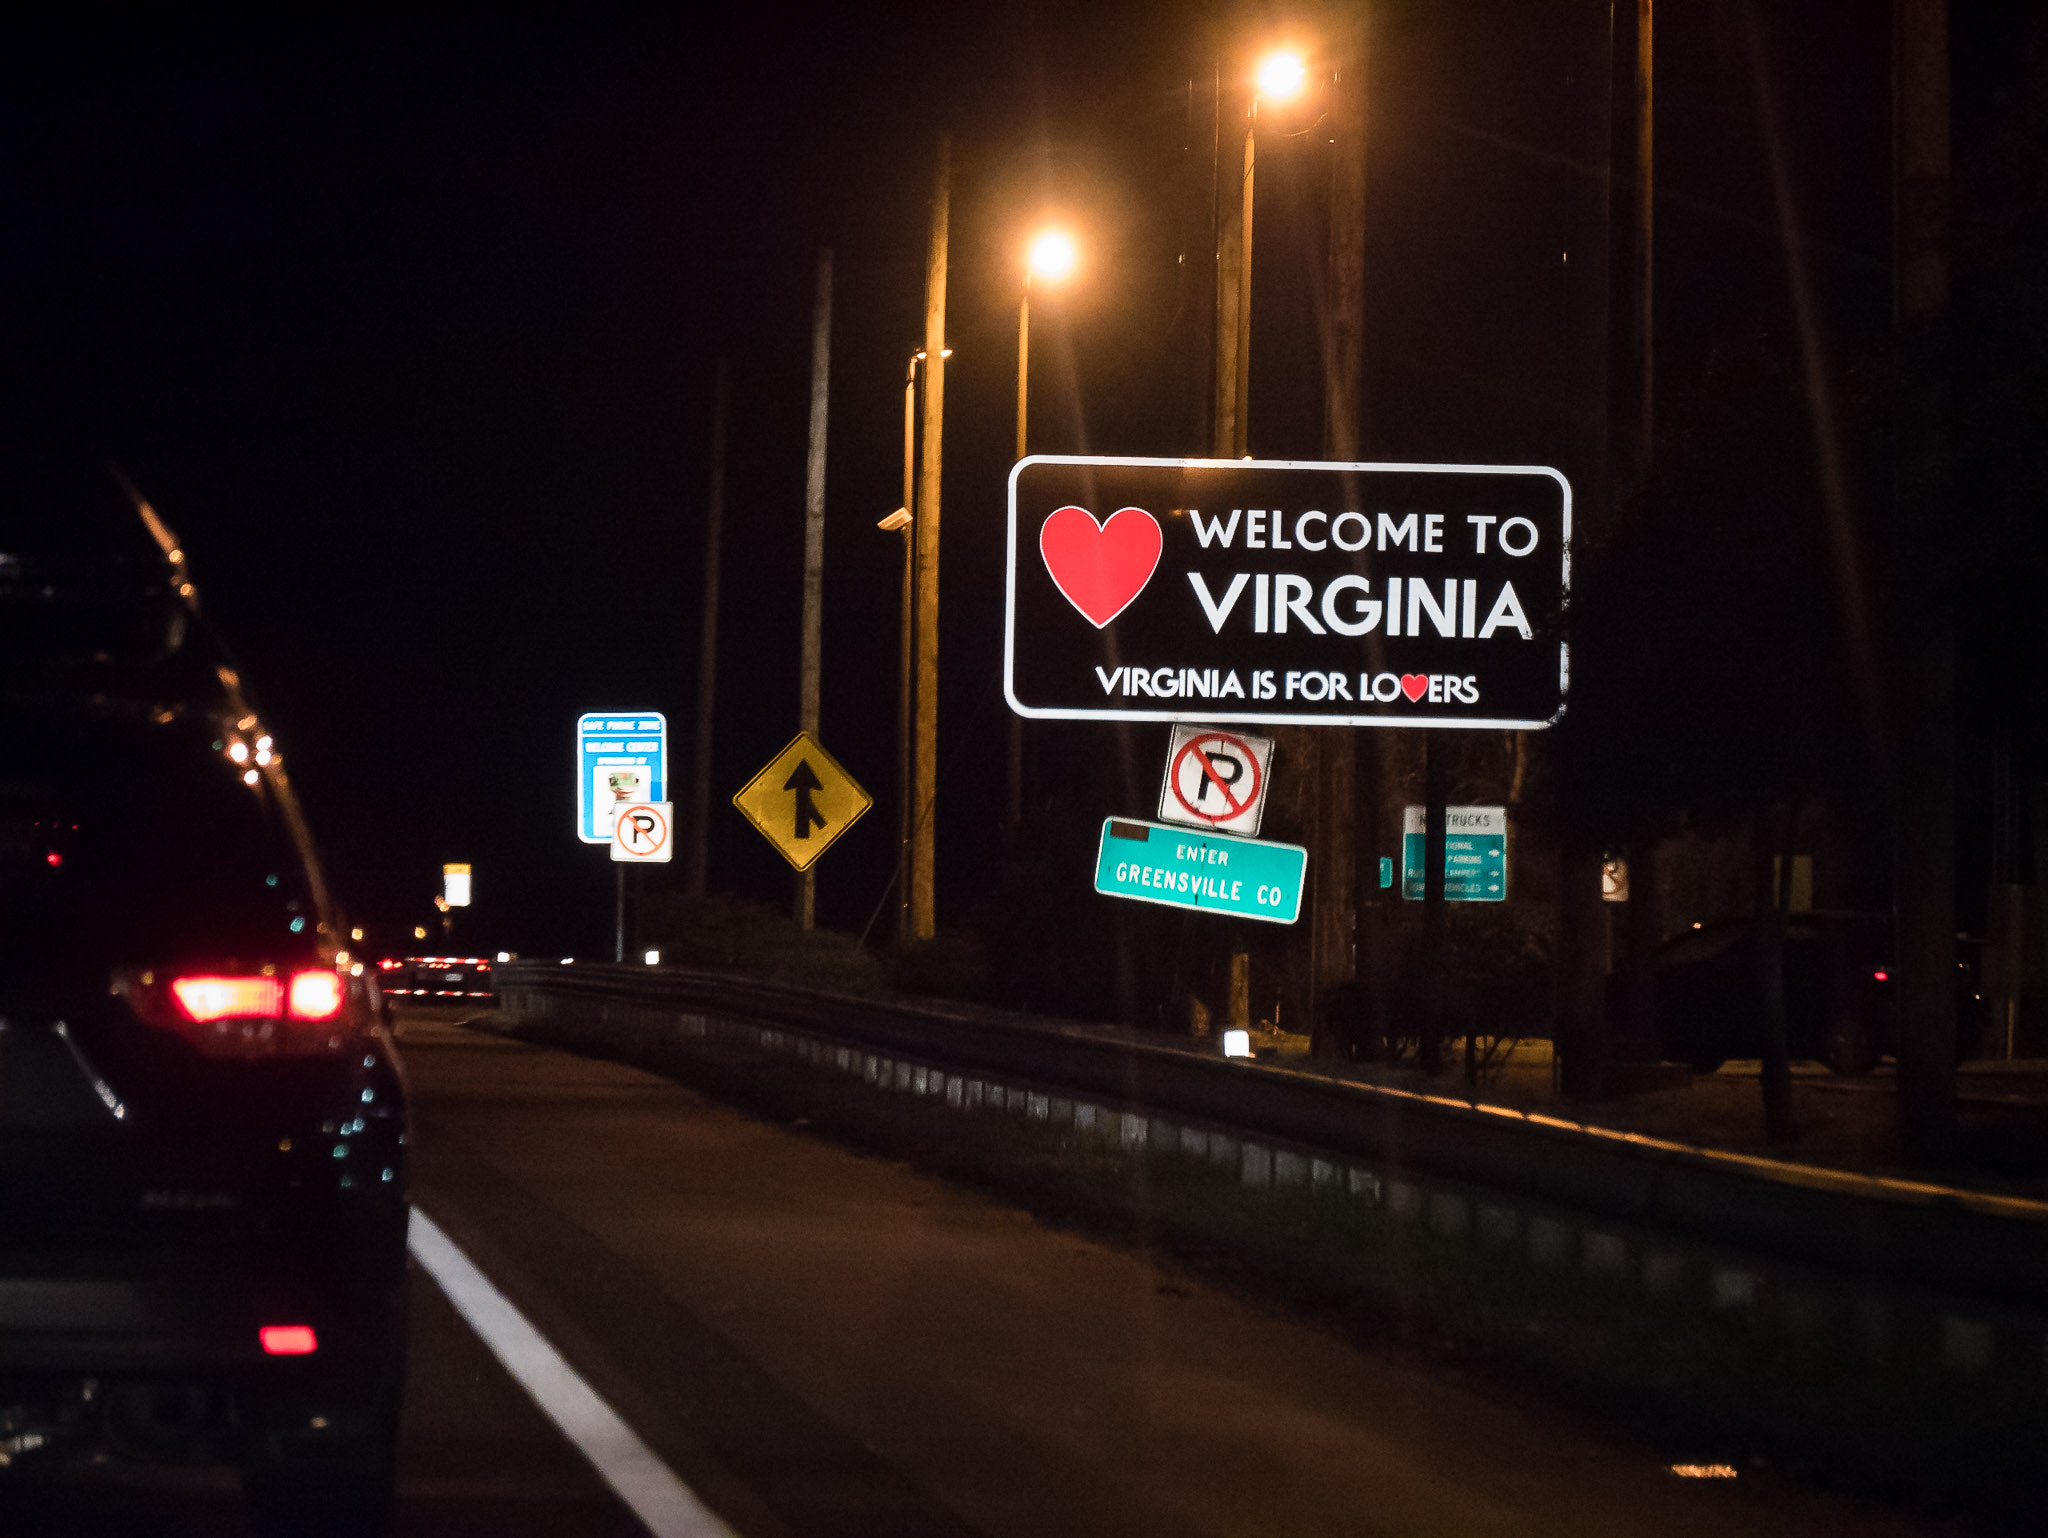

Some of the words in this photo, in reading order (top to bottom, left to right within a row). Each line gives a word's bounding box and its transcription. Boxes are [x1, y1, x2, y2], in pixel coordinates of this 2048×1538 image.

[1189, 509, 1445, 553] WELCOME
[1467, 515, 1539, 557] TO
[1187, 572, 1534, 640] VIRGINIA
[1095, 666, 1246, 699] VIRGINIA
[1252, 670, 1277, 700] IS
[1285, 671, 1354, 701] FOR
[1176, 844, 1230, 867] ENTER
[1116, 862, 1243, 901] GREENSVILLE
[1256, 884, 1282, 907] CO
